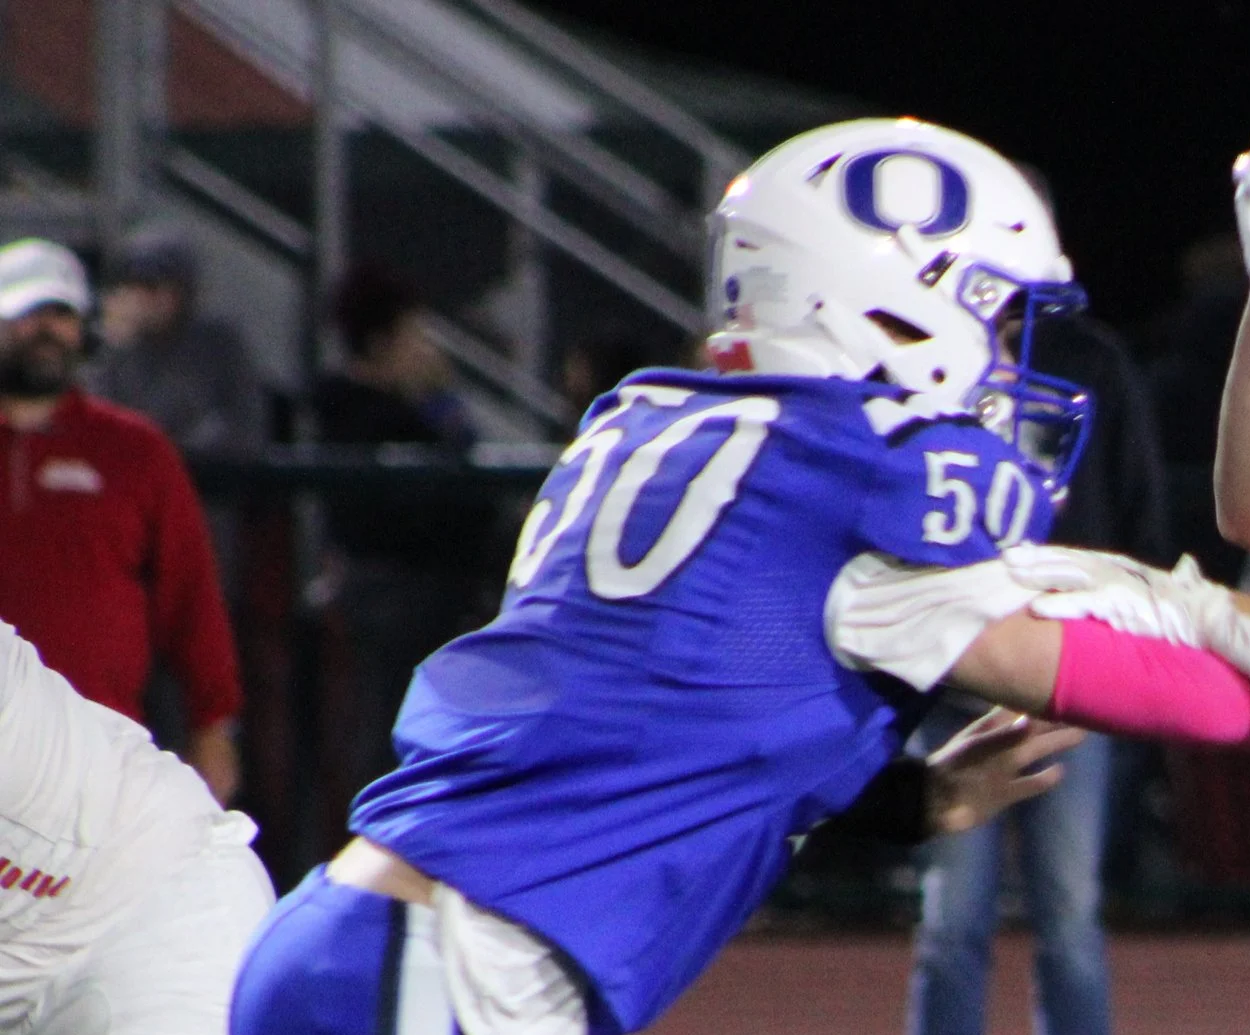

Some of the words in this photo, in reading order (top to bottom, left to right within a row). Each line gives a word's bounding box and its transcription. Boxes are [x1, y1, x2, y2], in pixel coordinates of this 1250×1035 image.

[842, 148, 971, 236] O
[508, 384, 780, 600] 50
[922, 450, 1035, 548] 50
